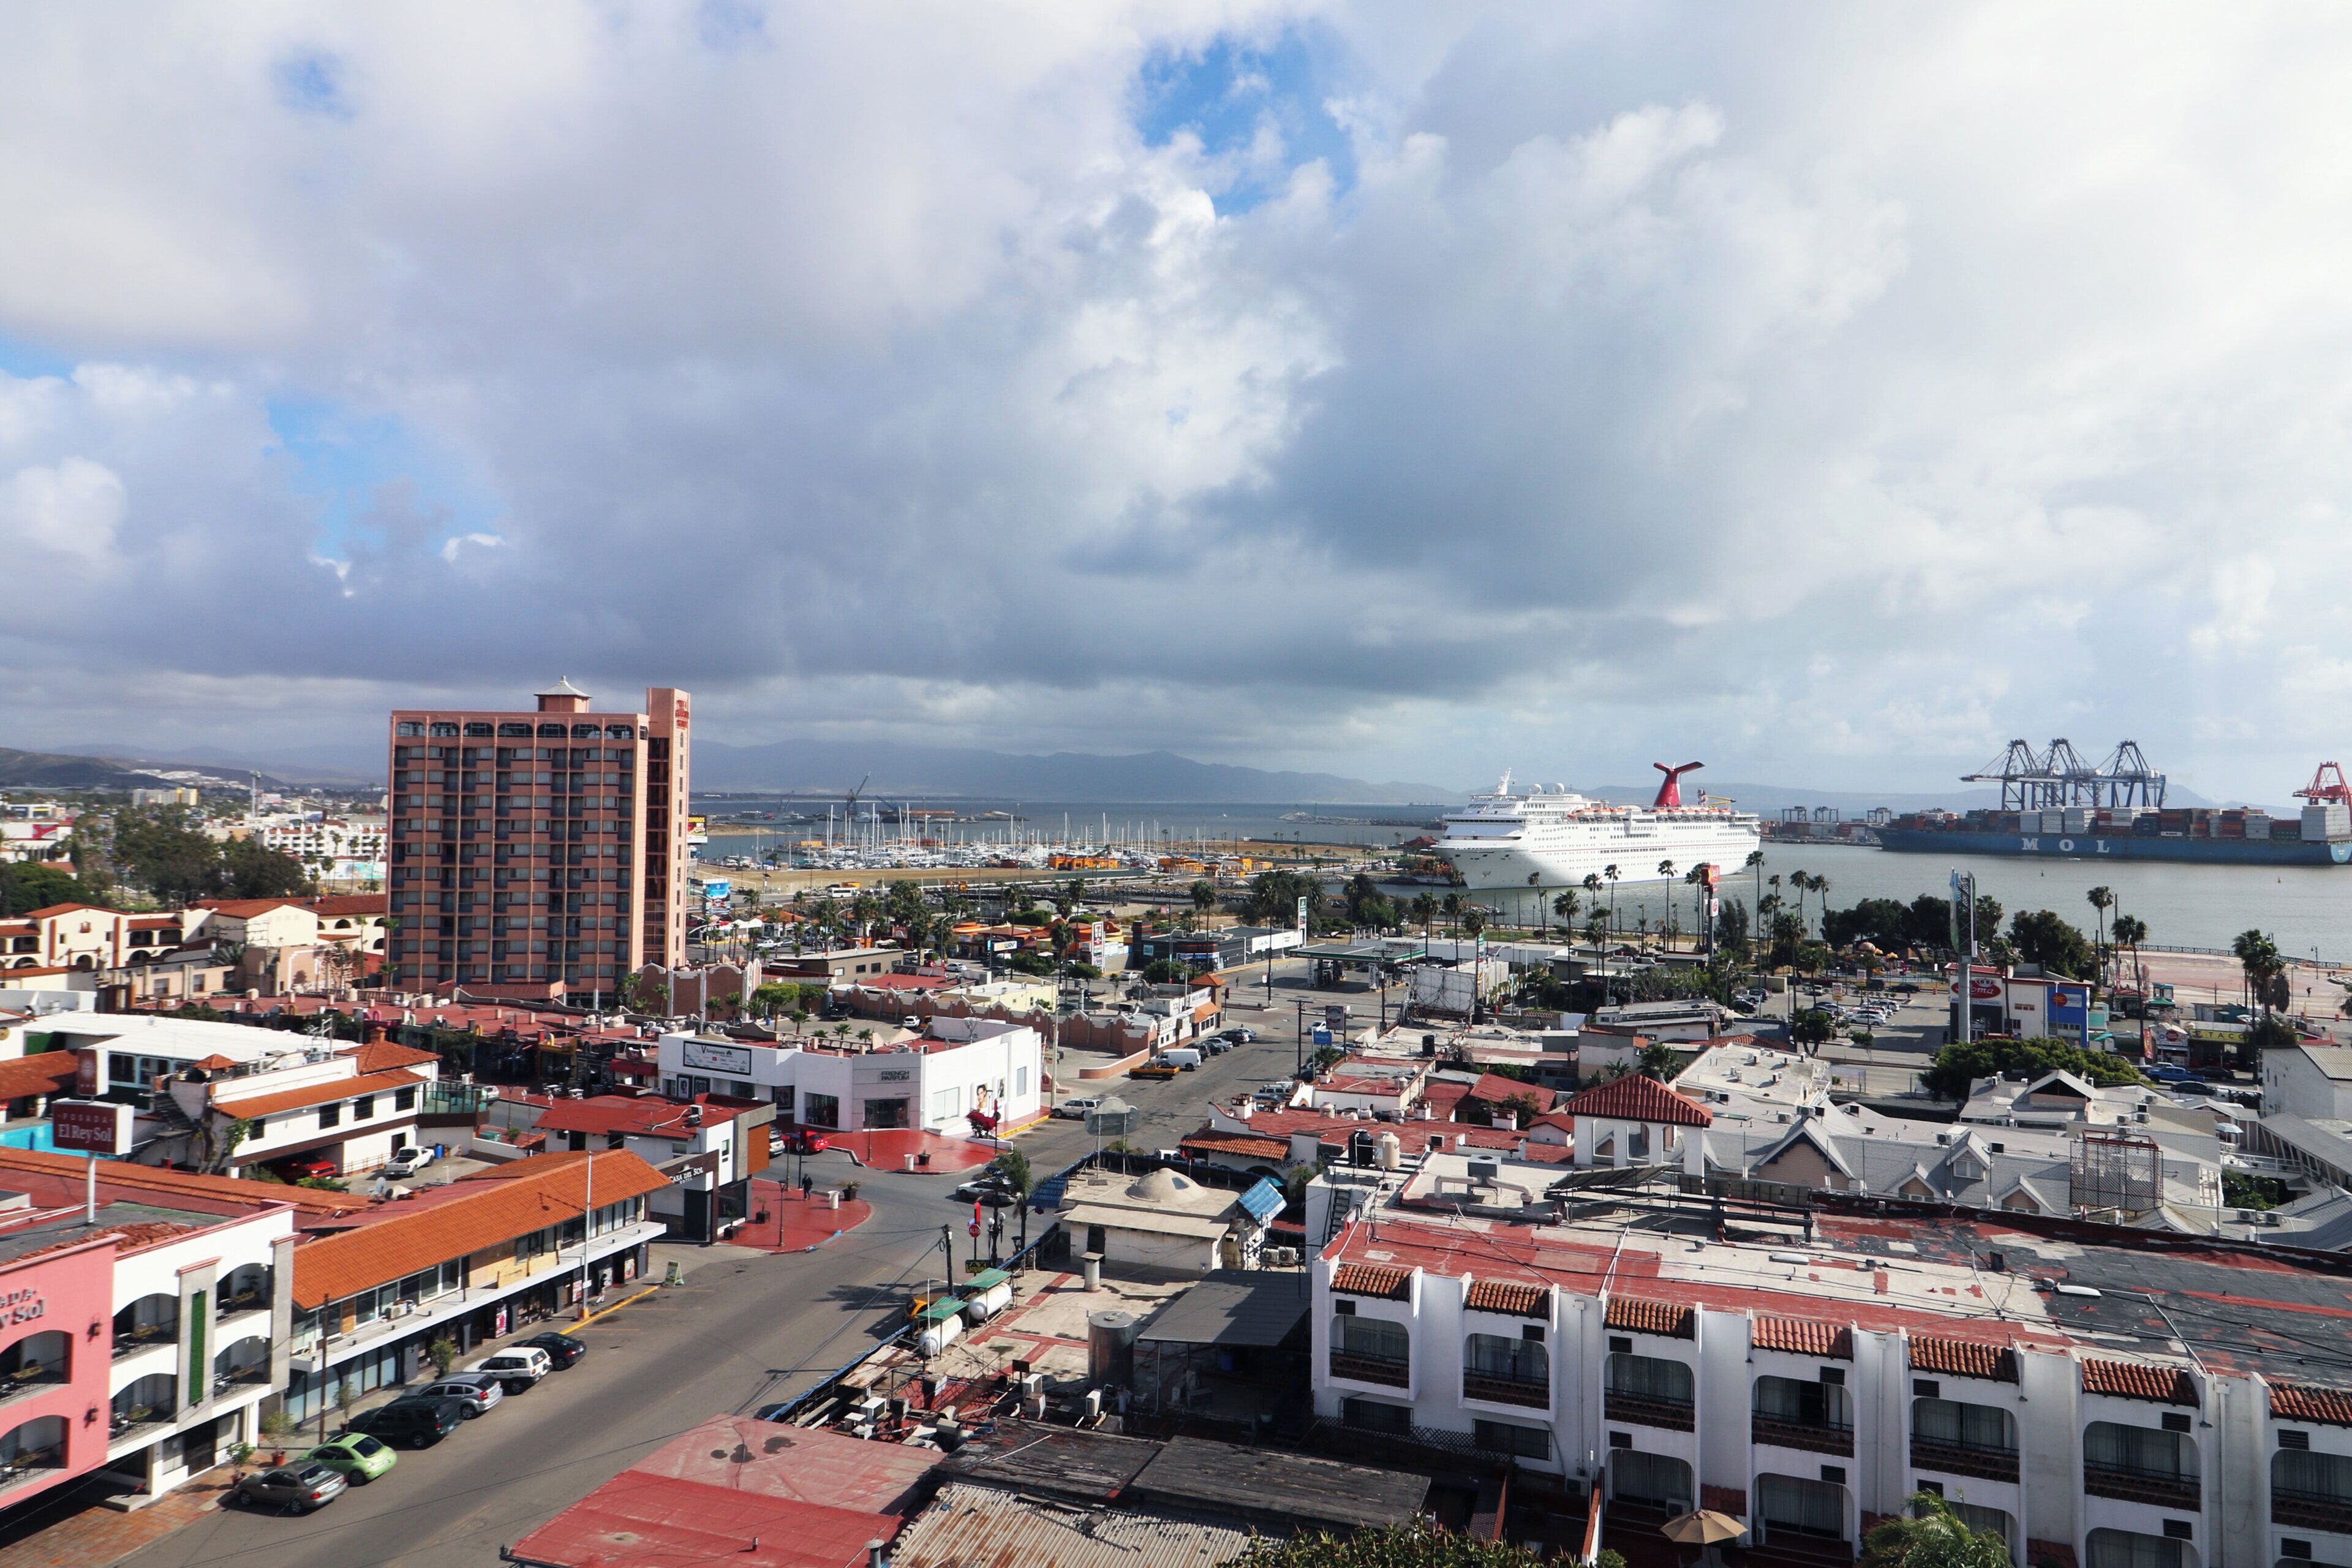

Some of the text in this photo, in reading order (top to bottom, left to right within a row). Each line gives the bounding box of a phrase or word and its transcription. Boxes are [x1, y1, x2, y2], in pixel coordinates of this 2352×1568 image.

[2022, 838, 2109, 853] MOL
[62, 1113, 108, 1123] POSADA
[58, 1124, 113, 1143] El Rey Sol
[13, 1297, 47, 1324] Sol
